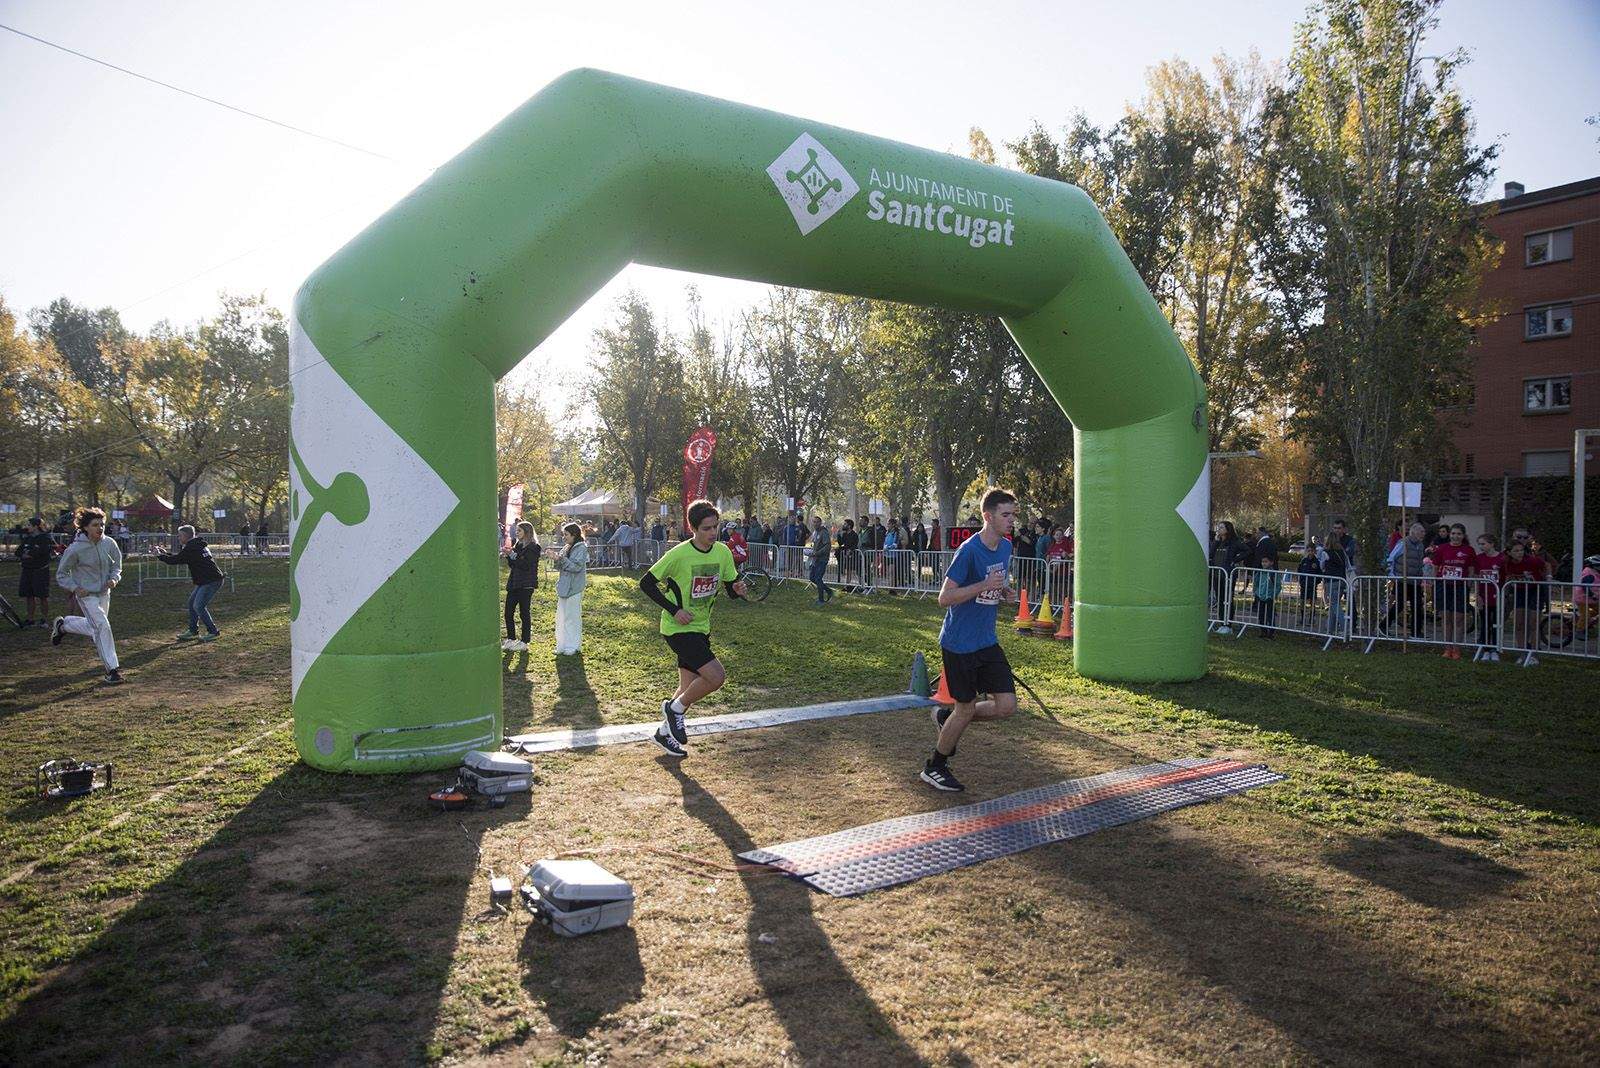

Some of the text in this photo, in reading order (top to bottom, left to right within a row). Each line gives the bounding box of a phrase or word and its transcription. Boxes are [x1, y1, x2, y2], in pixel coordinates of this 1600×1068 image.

[869, 168, 1015, 215] AJUNTAMENT DE
[866, 190, 1015, 247] SantCugat
